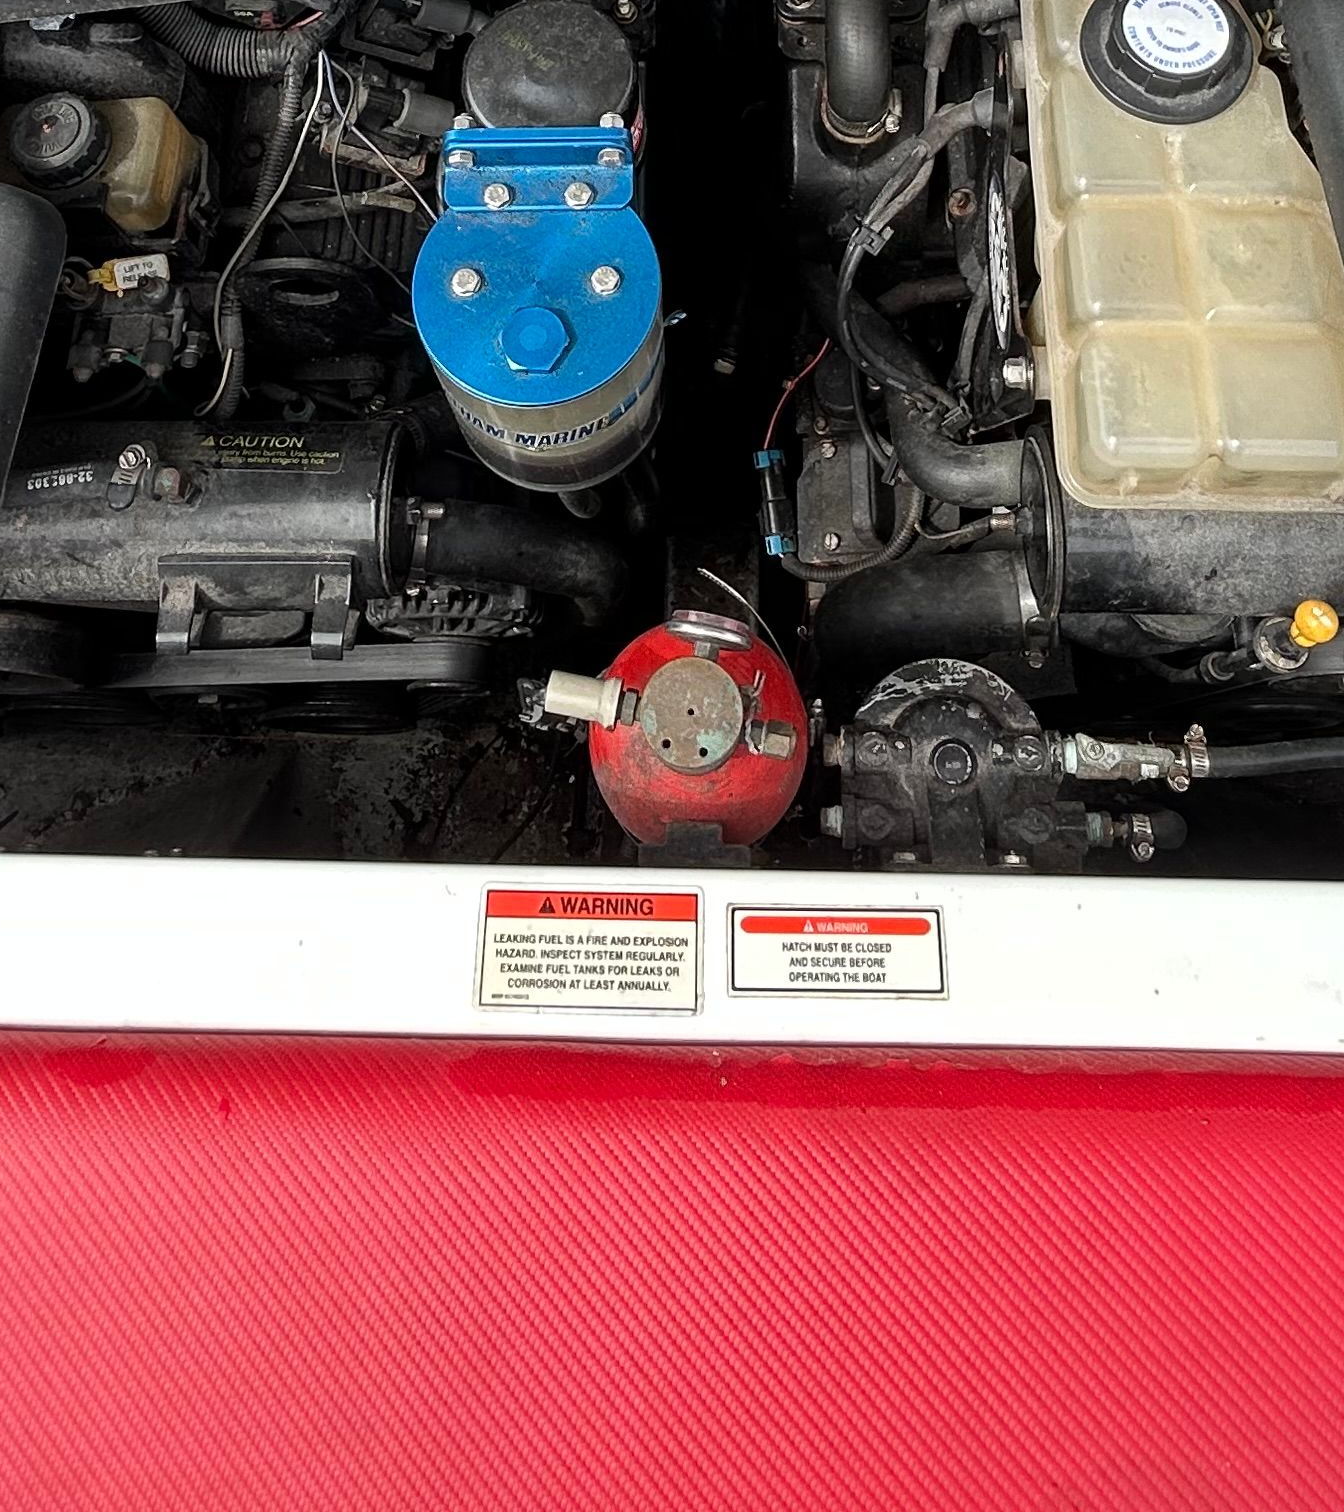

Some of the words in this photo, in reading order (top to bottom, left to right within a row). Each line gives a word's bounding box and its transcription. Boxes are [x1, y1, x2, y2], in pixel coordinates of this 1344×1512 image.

[218, 436, 304, 448] CAUTION
[561, 896, 654, 915] WARNING
[817, 922, 868, 933] WARNING
[494, 934, 536, 944] LEAKING
[538, 935, 563, 944] FUEL
[566, 936, 574, 945] IS
[577, 936, 584, 945] A
[586, 936, 607, 945] FIRE
[610, 936, 630, 946] AND
[633, 937, 688, 947] EXPLOSION
[782, 942, 812, 952] HATCH
[814, 942, 838, 952] MUST
[841, 943, 853, 952] BE
[856, 943, 892, 953] CLOSED
[496, 949, 538, 959] HAZARD.
[540, 950, 581, 960] INSPECT
[584, 950, 622, 960] SYSTEM
[625, 951, 685, 962] REGULARLY.
[789, 957, 808, 967] AND
[811, 957, 846, 967] SECURE
[849, 958, 885, 968] BEFORE
[500, 963, 543, 973] EXAMINE
[546, 964, 570, 974] FUEL
[574, 965, 605, 975] TANKS
[608, 966, 627, 976] FOR
[630, 966, 662, 976] LEAKS
[665, 967, 680, 976] OR
[788, 972, 840, 982] OPERATING
[843, 973, 860, 982] THE
[863, 973, 886, 982] BOAT
[507, 978, 566, 989] CORROSION
[569, 980, 580, 989] AT
[583, 980, 614, 990] LEAST
[617, 981, 671, 992] ANNUALLY.
